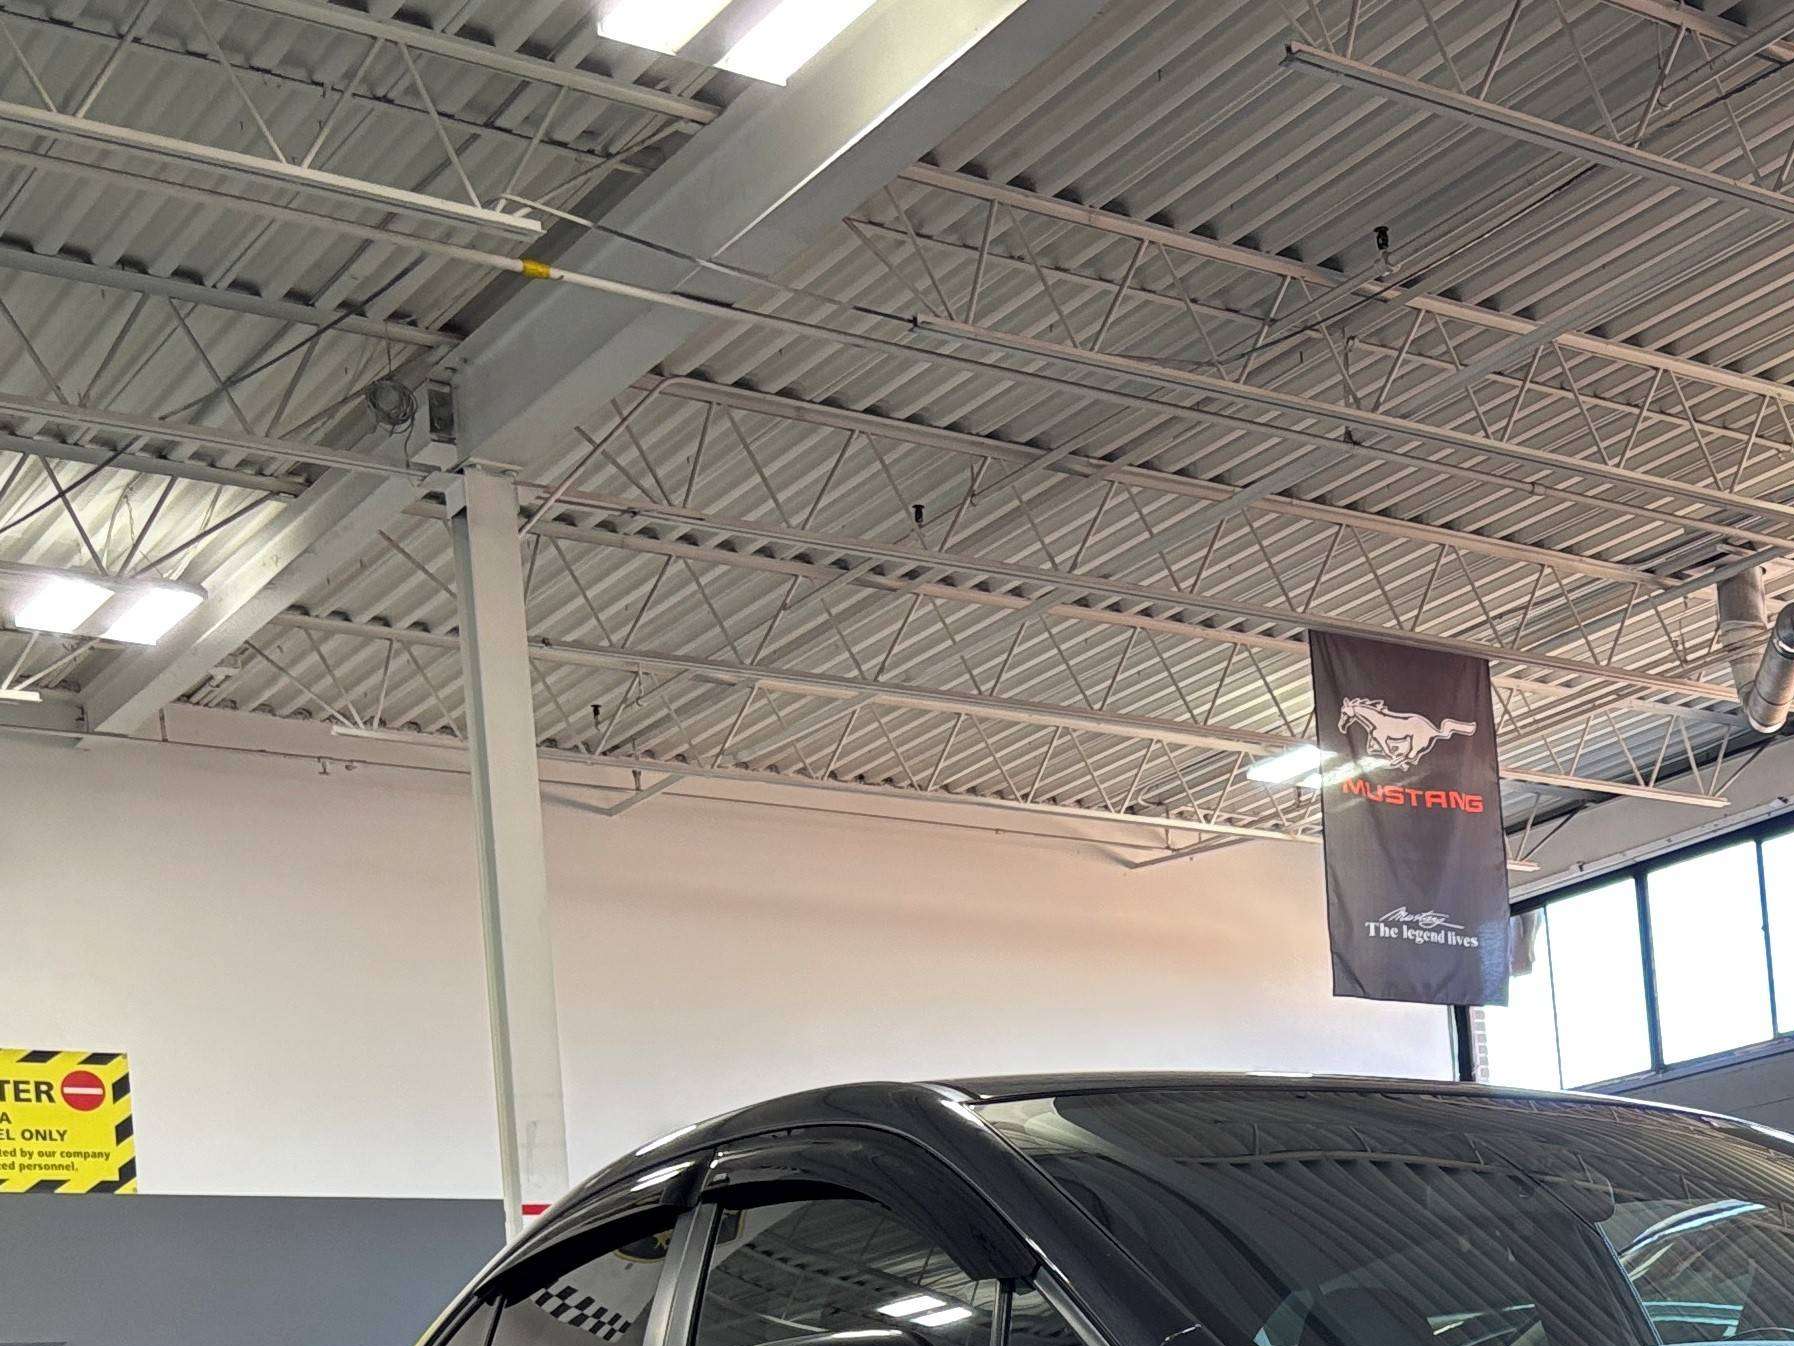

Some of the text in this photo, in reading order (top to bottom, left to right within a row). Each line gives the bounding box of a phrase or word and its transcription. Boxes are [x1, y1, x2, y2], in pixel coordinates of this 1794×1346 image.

[1342, 778, 1484, 814] MUSTANG
[1378, 906, 1465, 930] Mustang
[1364, 921, 1479, 948] The legend lives
[21, 1128, 68, 1142] ONLY
[0, 1147, 111, 1161] ed by our company
[0, 1160, 79, 1173] ed personnel.
